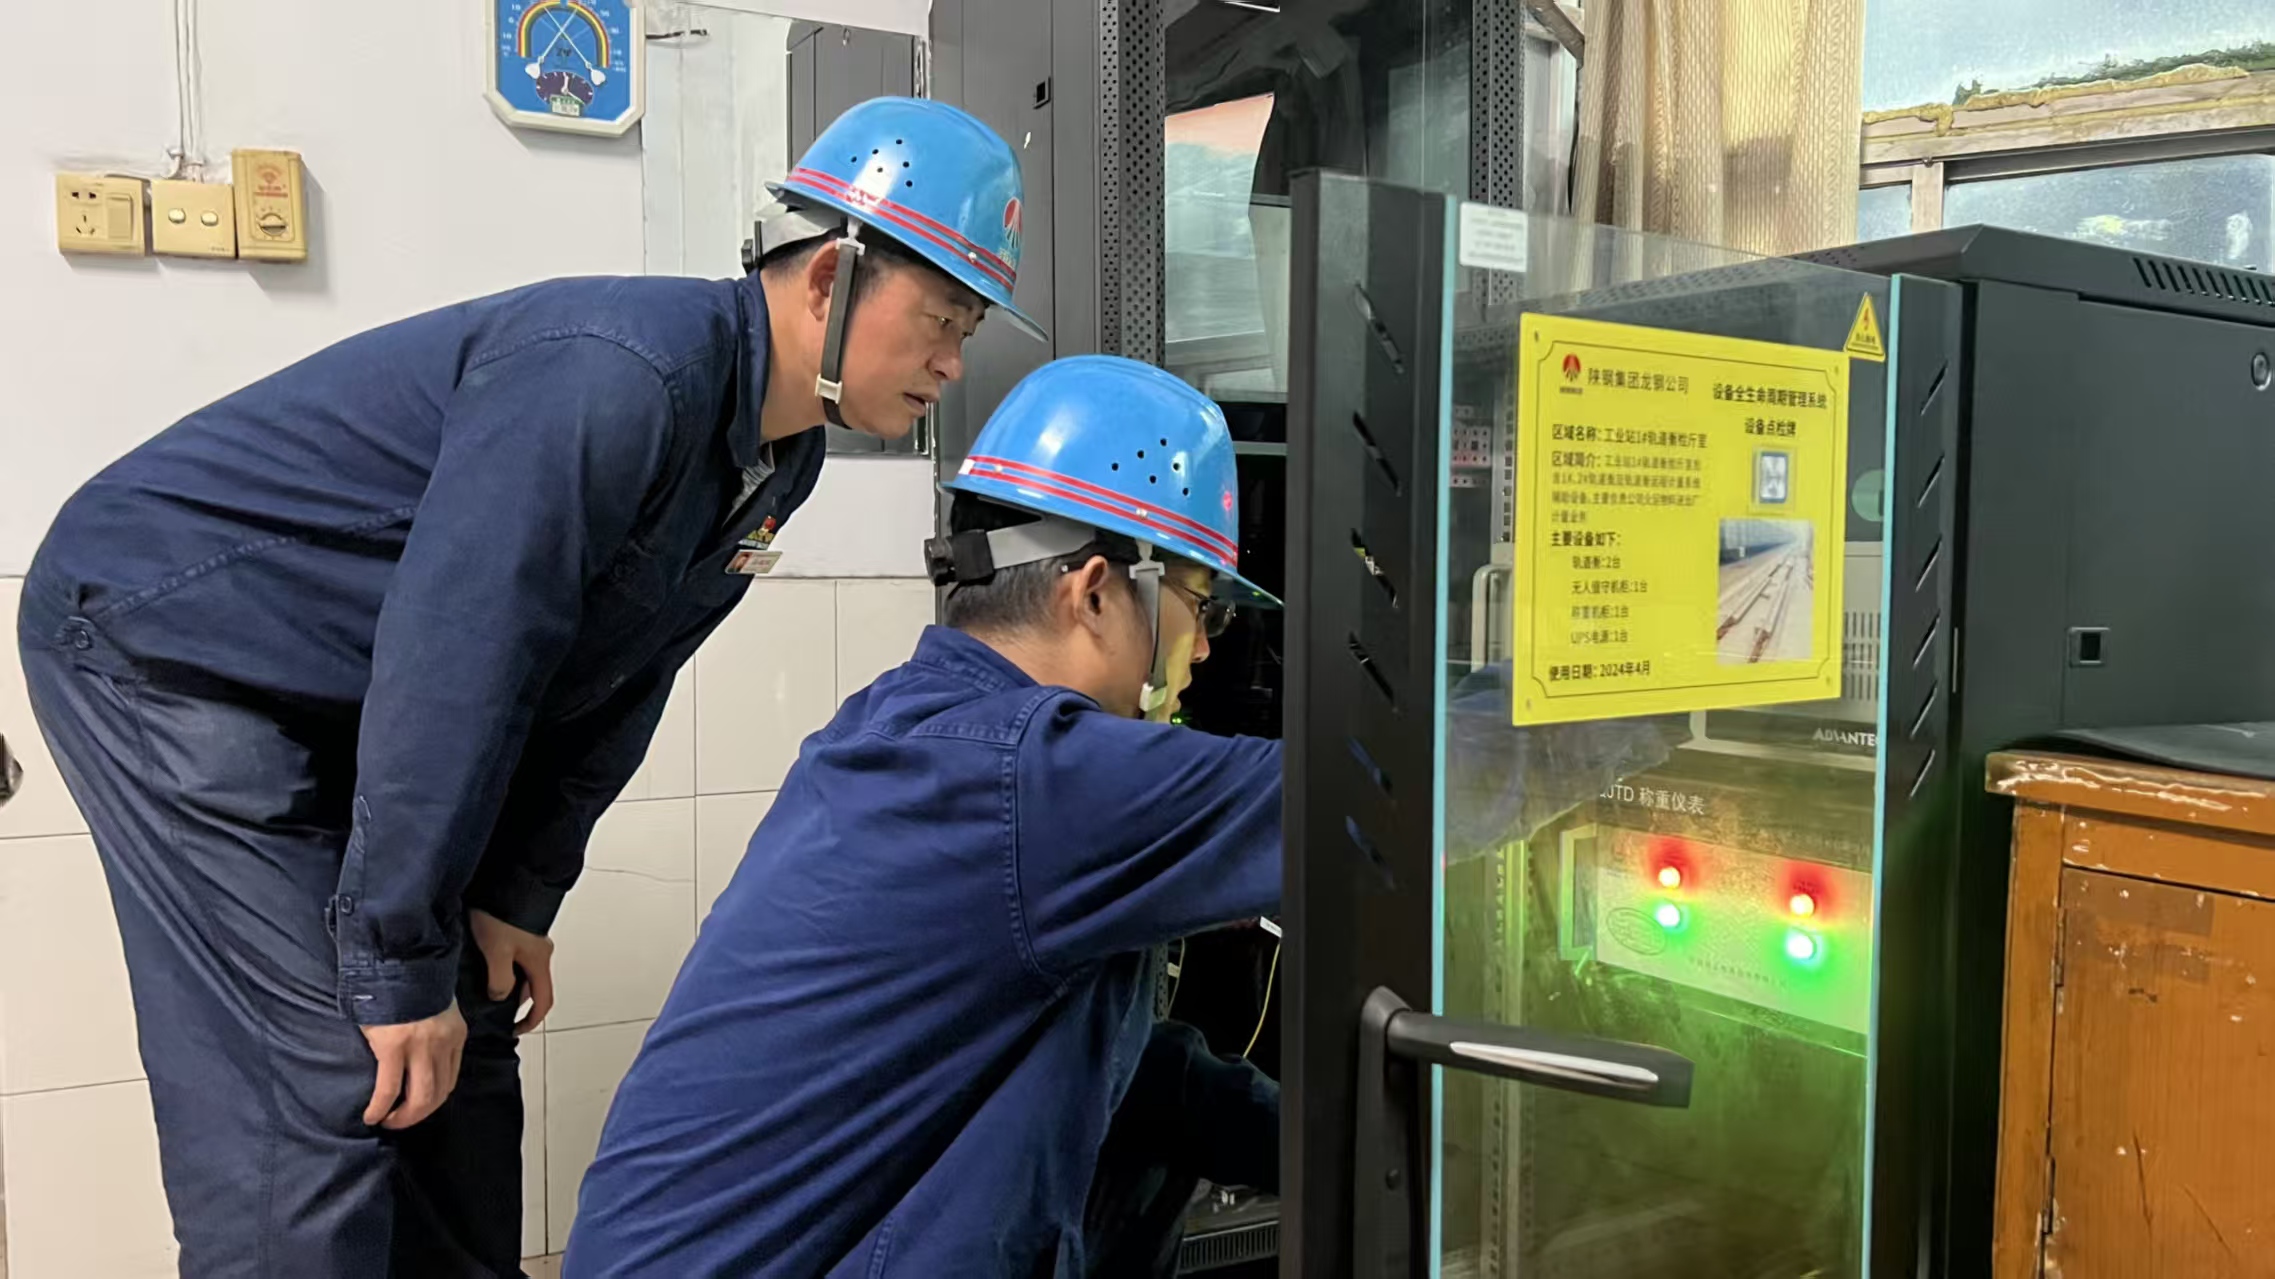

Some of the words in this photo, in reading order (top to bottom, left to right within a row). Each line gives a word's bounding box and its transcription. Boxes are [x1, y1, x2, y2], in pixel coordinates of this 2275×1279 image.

[1587, 367, 1690, 394] 陕钢集团龙钢公司
[1713, 383, 1827, 409] 设备全生命周期管理系统
[1744, 417, 1797, 437] 设备点检牌
[1639, 787, 1705, 816] 称重仪表
